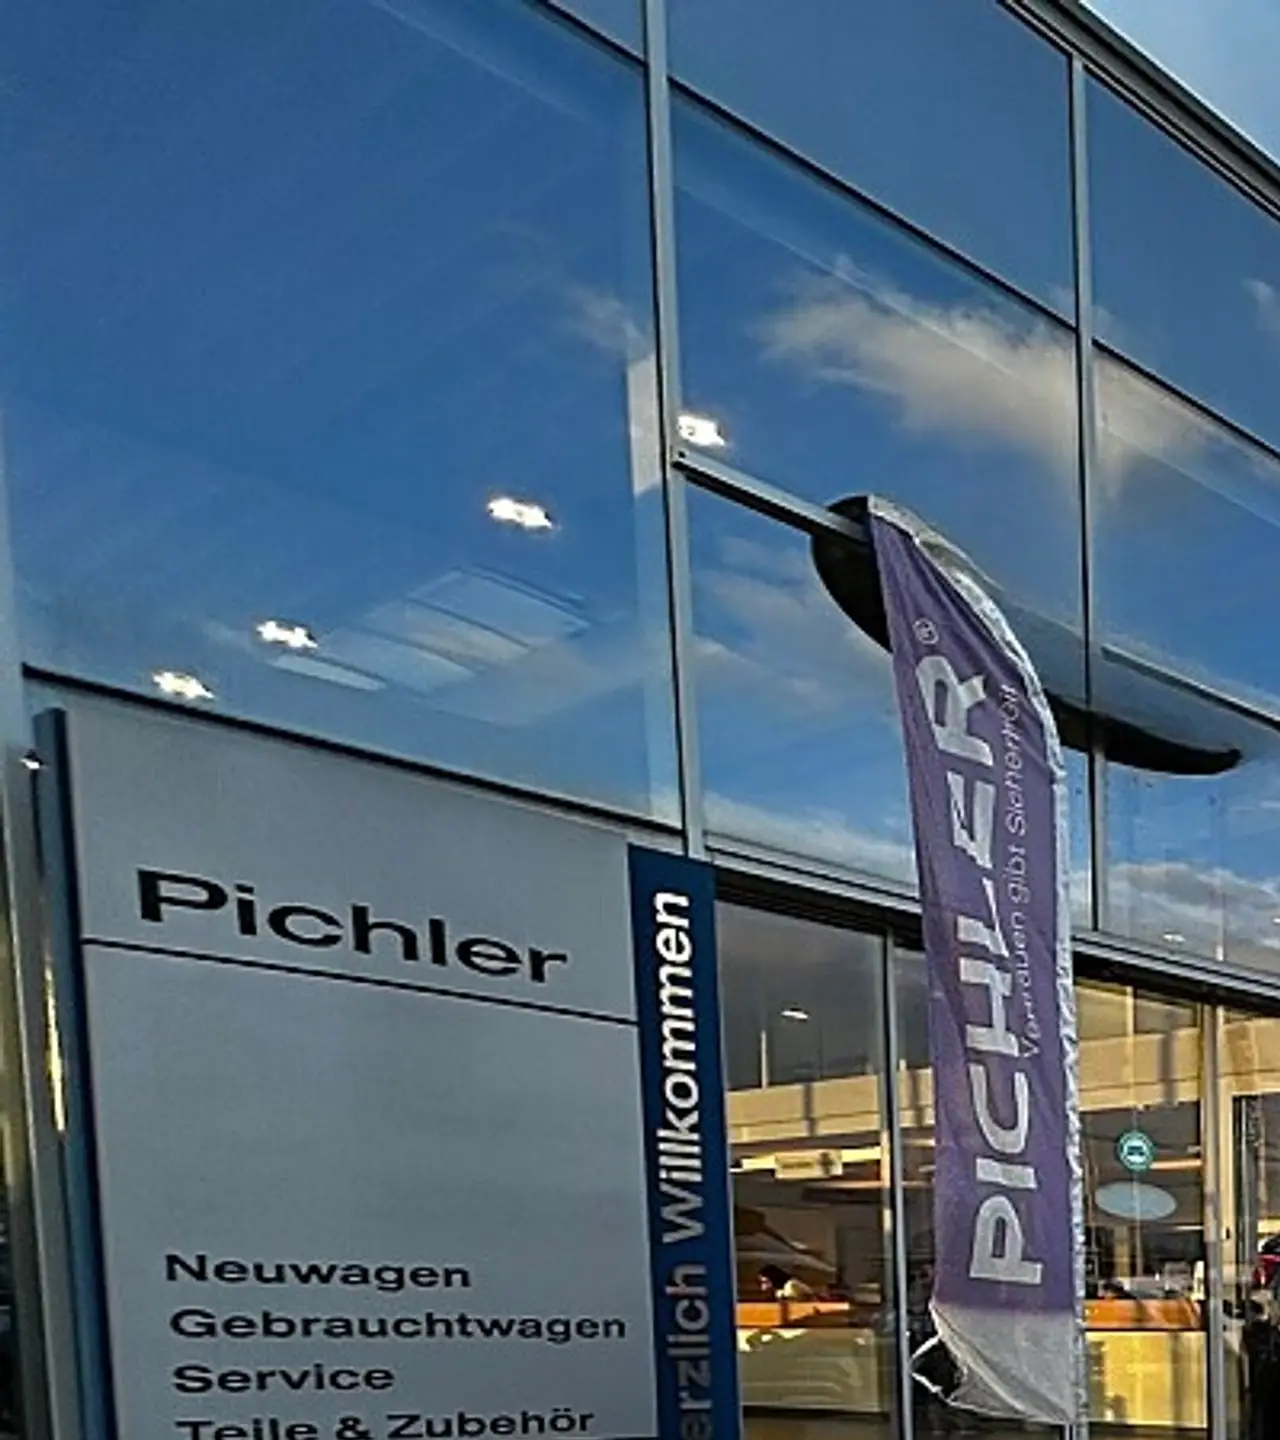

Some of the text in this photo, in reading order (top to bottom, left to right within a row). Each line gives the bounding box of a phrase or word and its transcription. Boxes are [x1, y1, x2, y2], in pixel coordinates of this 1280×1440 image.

[137, 869, 568, 983] Pichler
[651, 892, 706, 1243] Willkommen
[165, 1253, 471, 1291] Neuwagen
[170, 1309, 627, 1343] Gebrauchtwagen
[173, 1364, 395, 1394] Service
[387, 1406, 595, 1440] Zubehör
